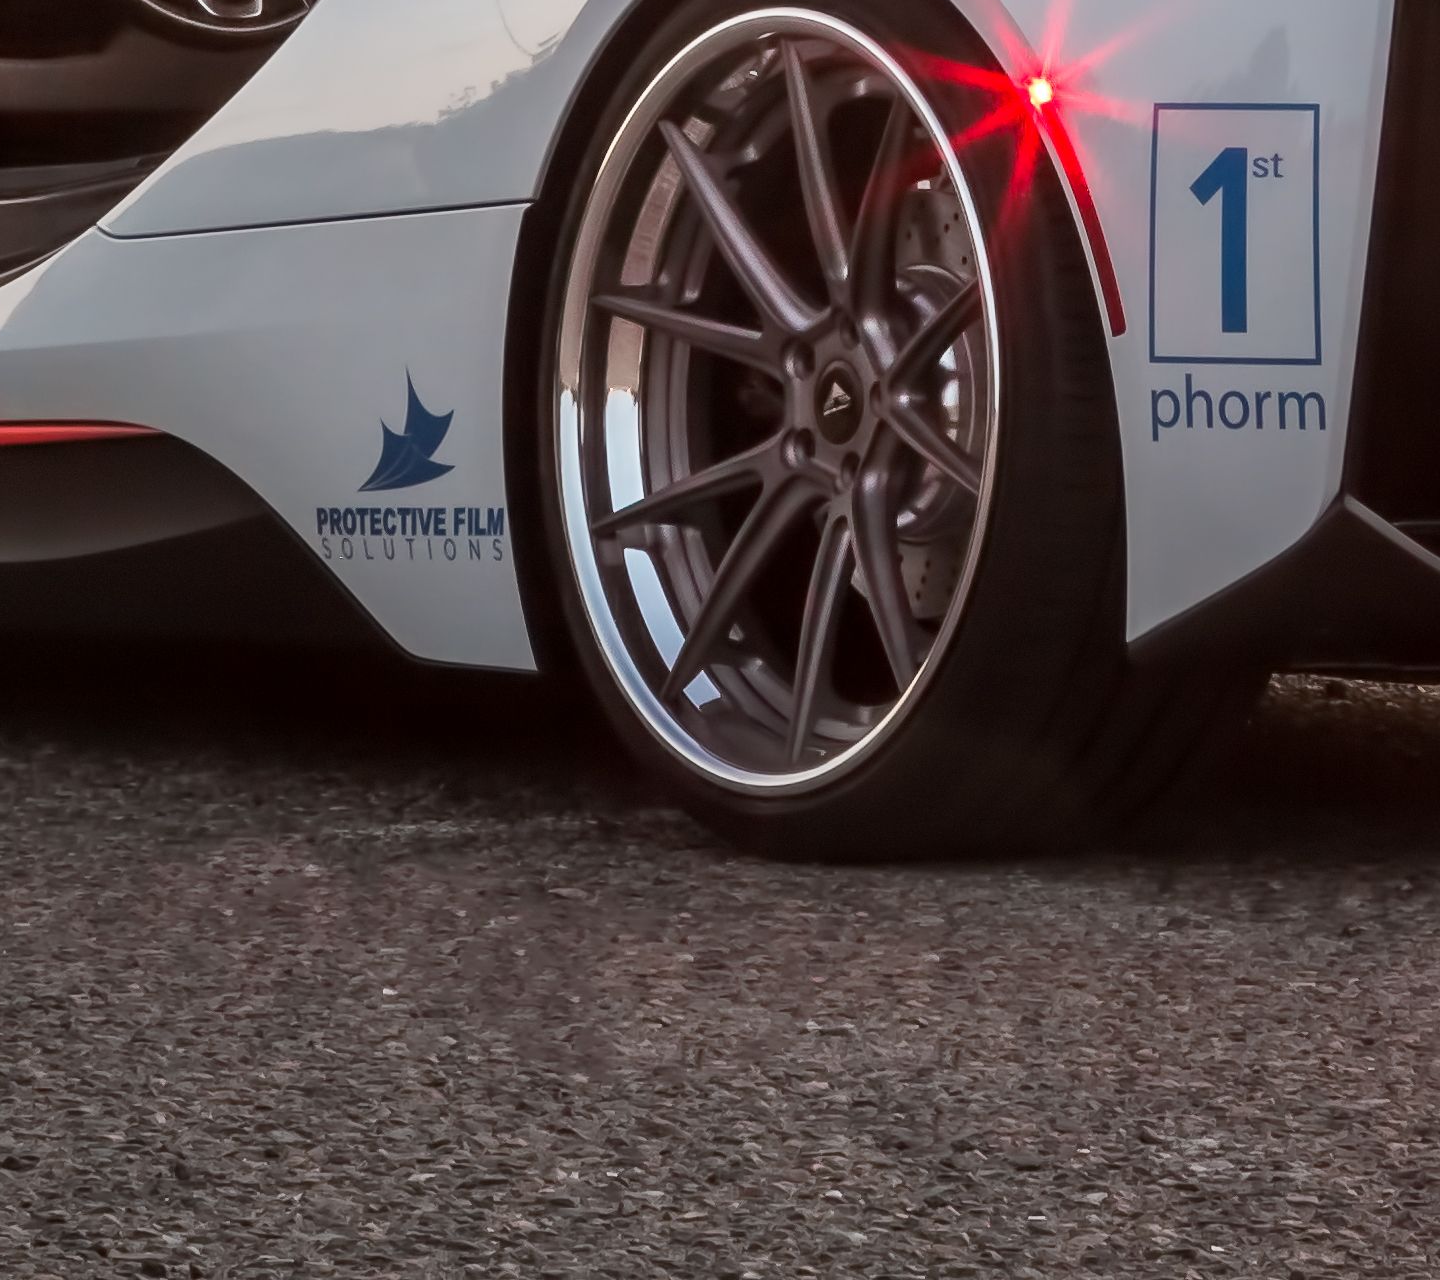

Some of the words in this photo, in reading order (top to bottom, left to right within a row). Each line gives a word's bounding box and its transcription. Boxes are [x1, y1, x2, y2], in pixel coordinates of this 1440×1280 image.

[1151, 373, 1326, 442] phorm
[316, 507, 447, 536] PROTECTIVE
[453, 507, 505, 536] FILM
[320, 538, 504, 562] SOLUTIONS
